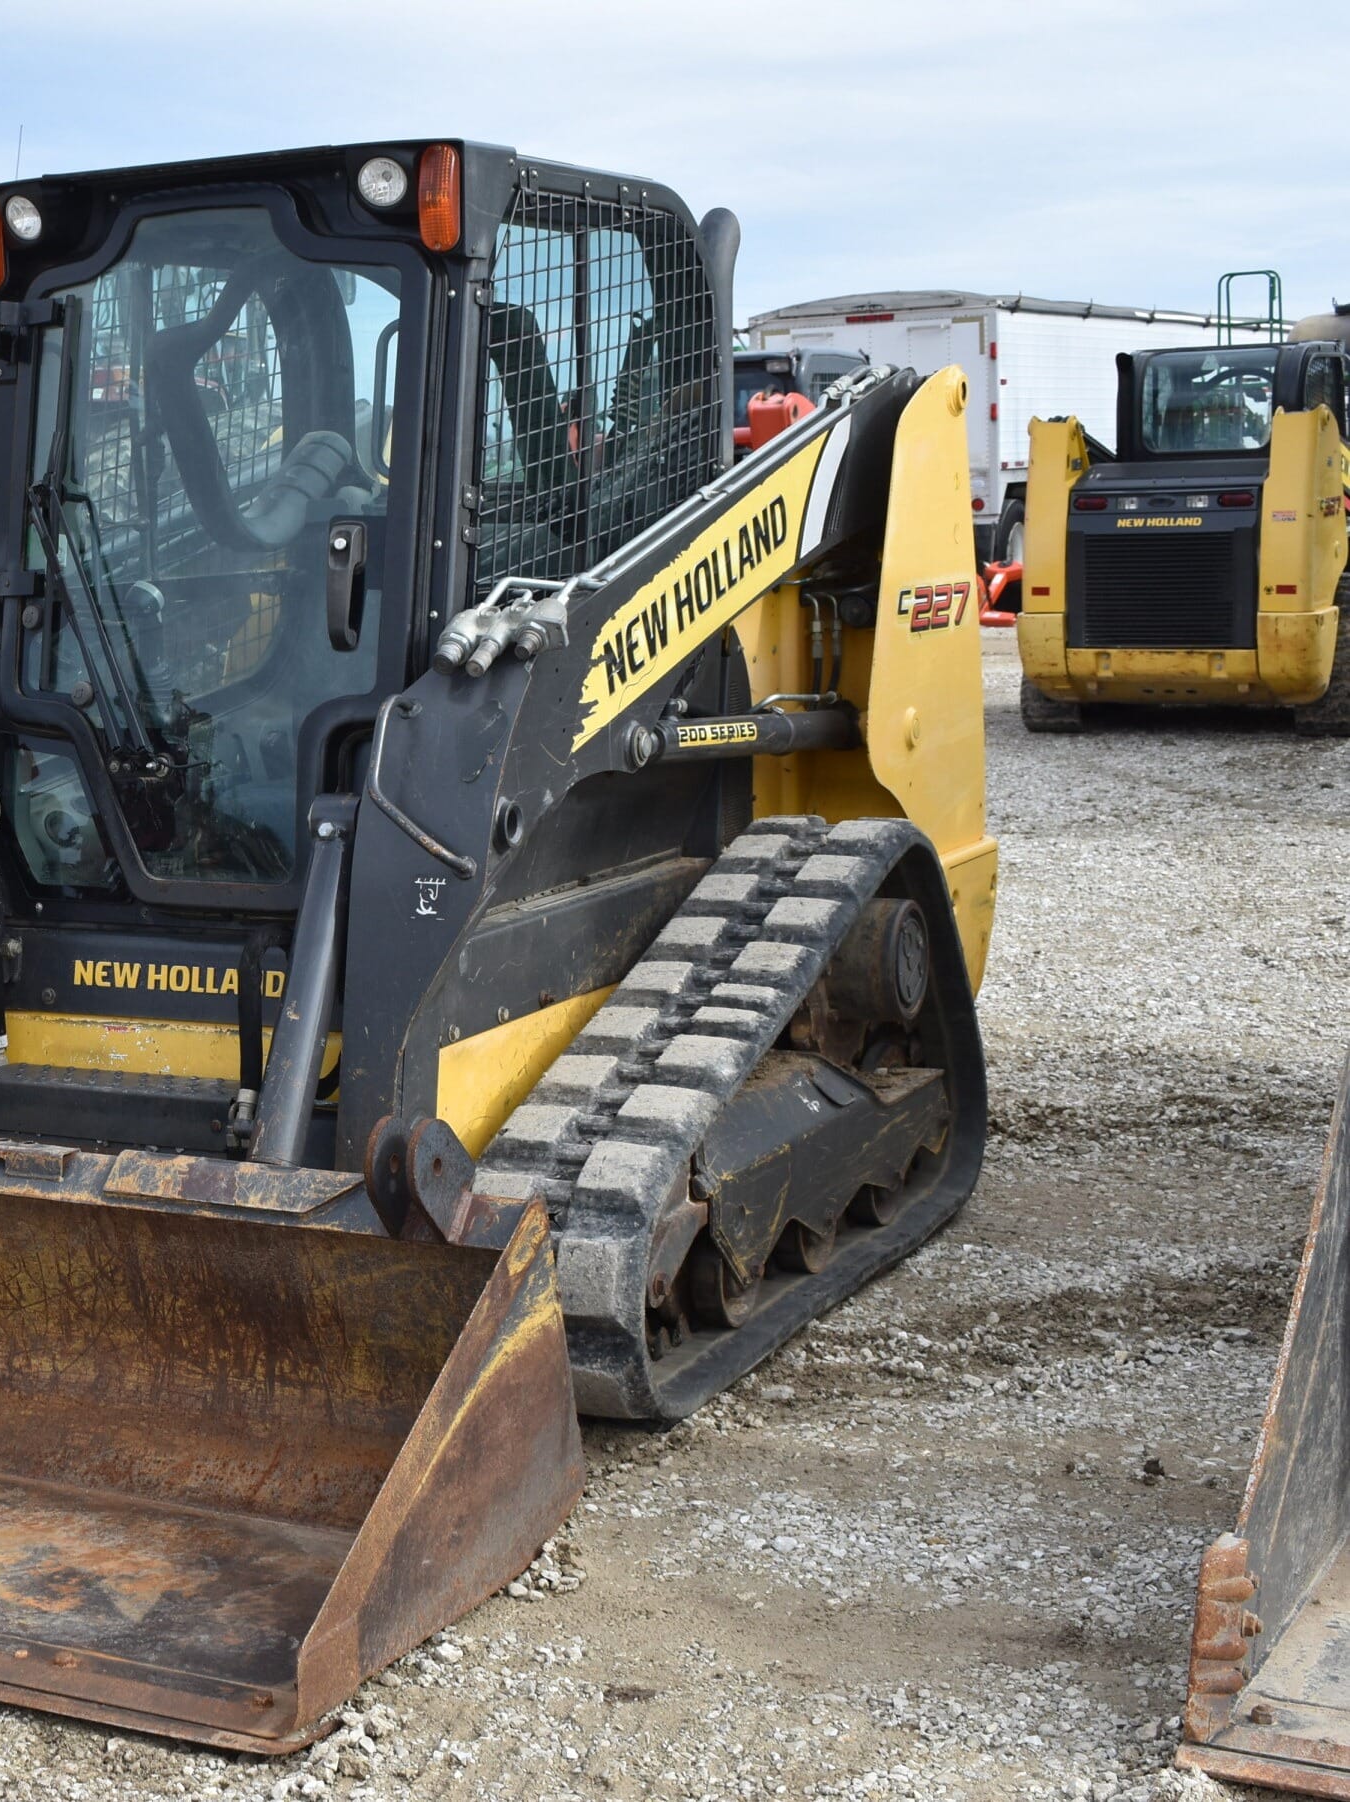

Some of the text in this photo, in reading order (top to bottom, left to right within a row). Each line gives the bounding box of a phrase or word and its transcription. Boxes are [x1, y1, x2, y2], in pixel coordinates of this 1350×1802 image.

[1116, 517, 1202, 528] NEW HOLLAND
[603, 494, 787, 696] NEW HOLLAND
[897, 582, 970, 632] C227
[679, 724, 755, 742] 200 SERIES
[73, 959, 286, 998] NEW HOLLAD
